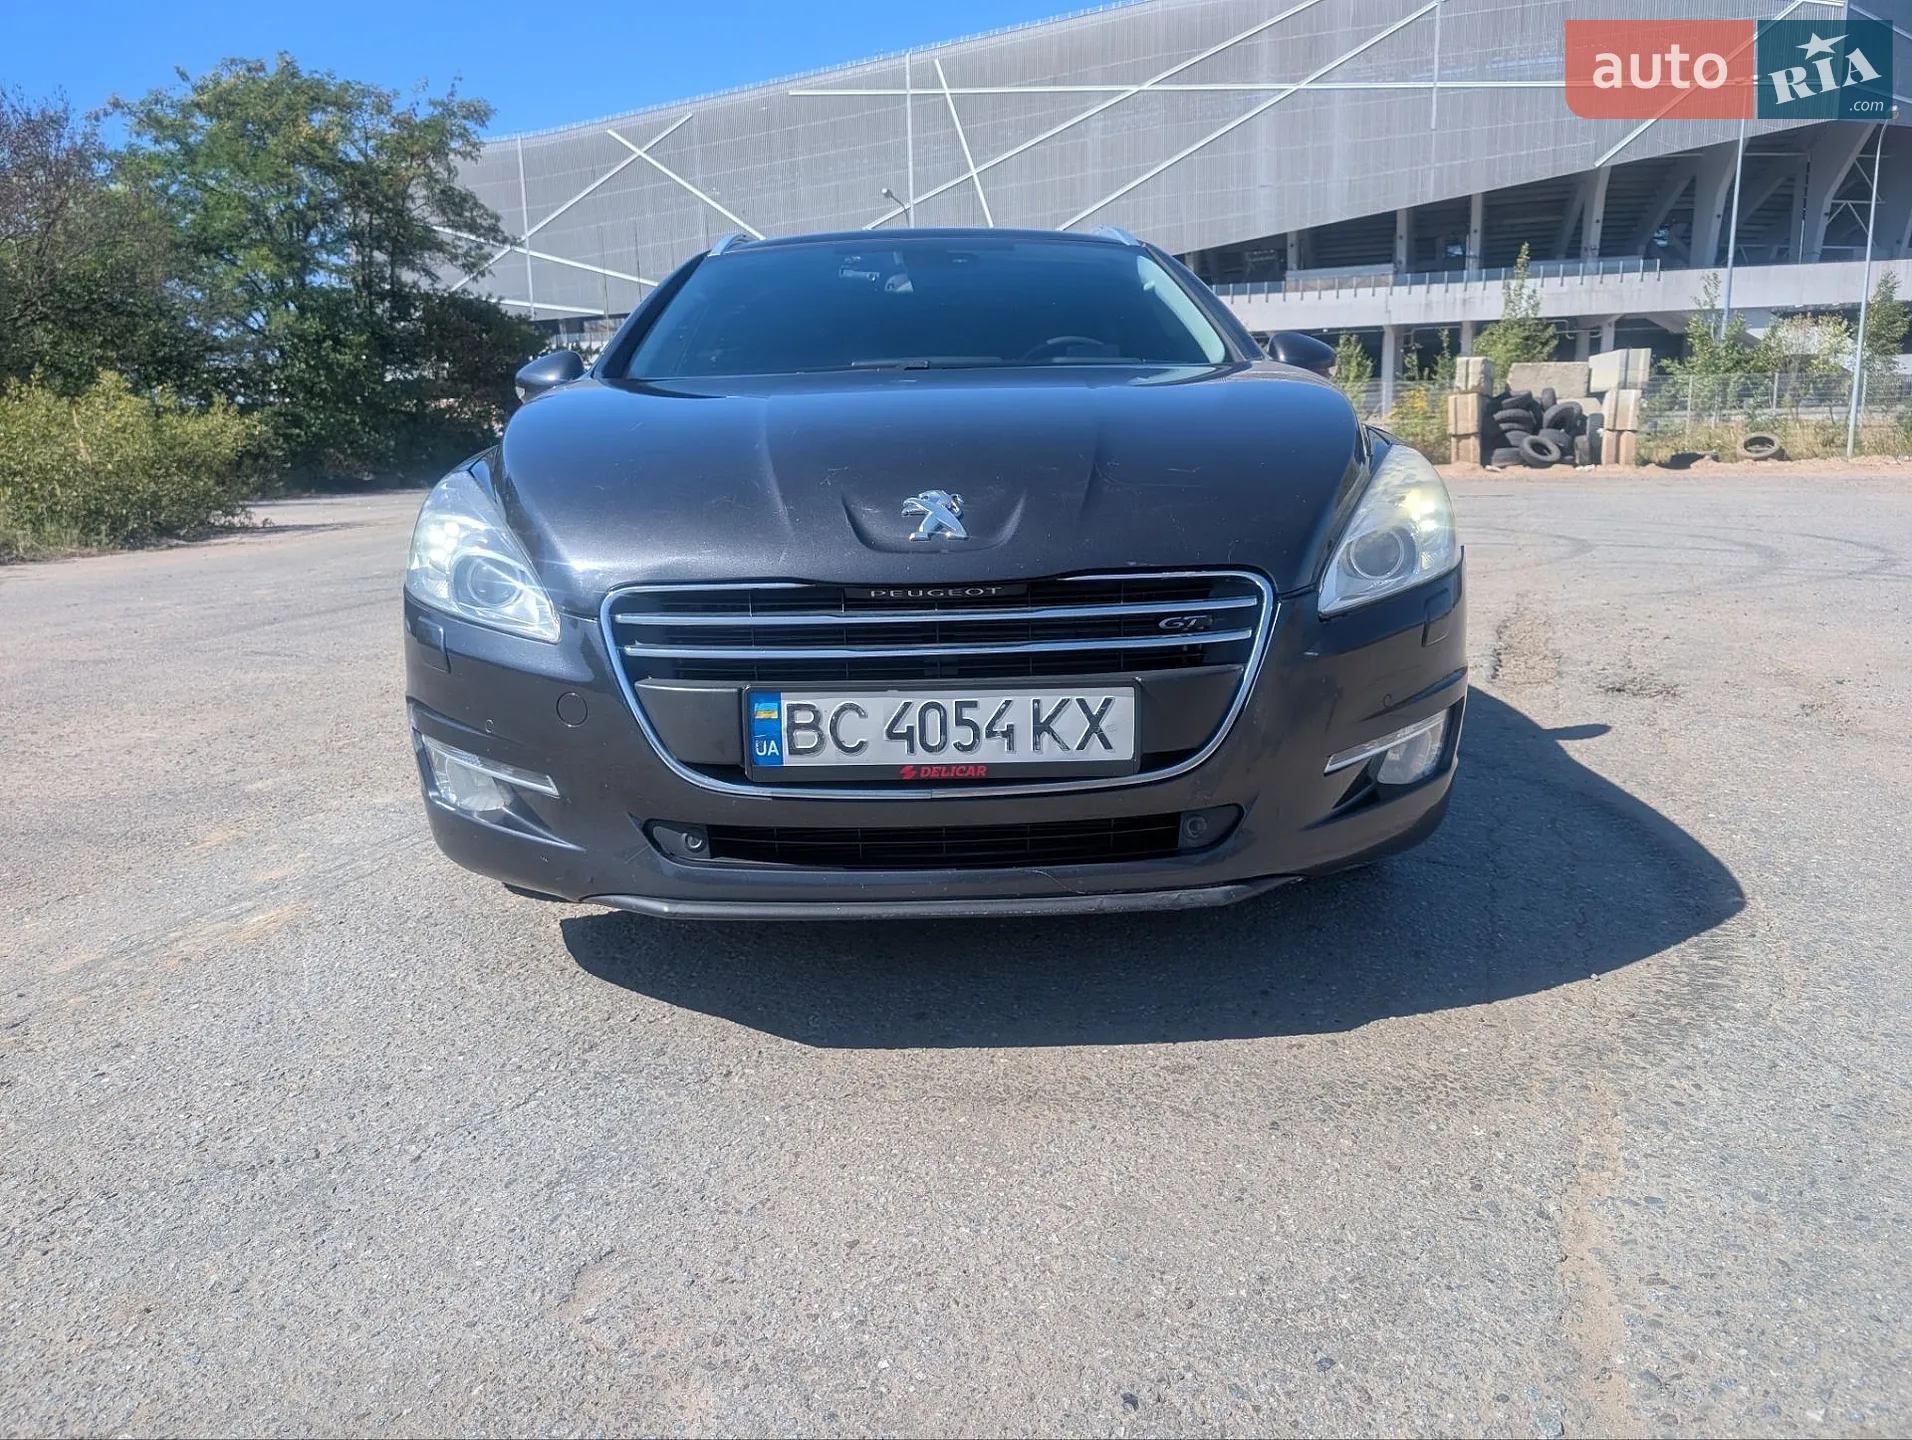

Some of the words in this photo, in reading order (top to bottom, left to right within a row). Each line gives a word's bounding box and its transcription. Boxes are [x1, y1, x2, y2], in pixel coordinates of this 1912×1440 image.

[869, 586, 1002, 597] PEUGEOT
[786, 701, 869, 756] BC
[884, 699, 1016, 755] 4054
[1031, 697, 1115, 752] KX
[755, 738, 780, 757] UA
[920, 765, 986, 778] DELICAR
